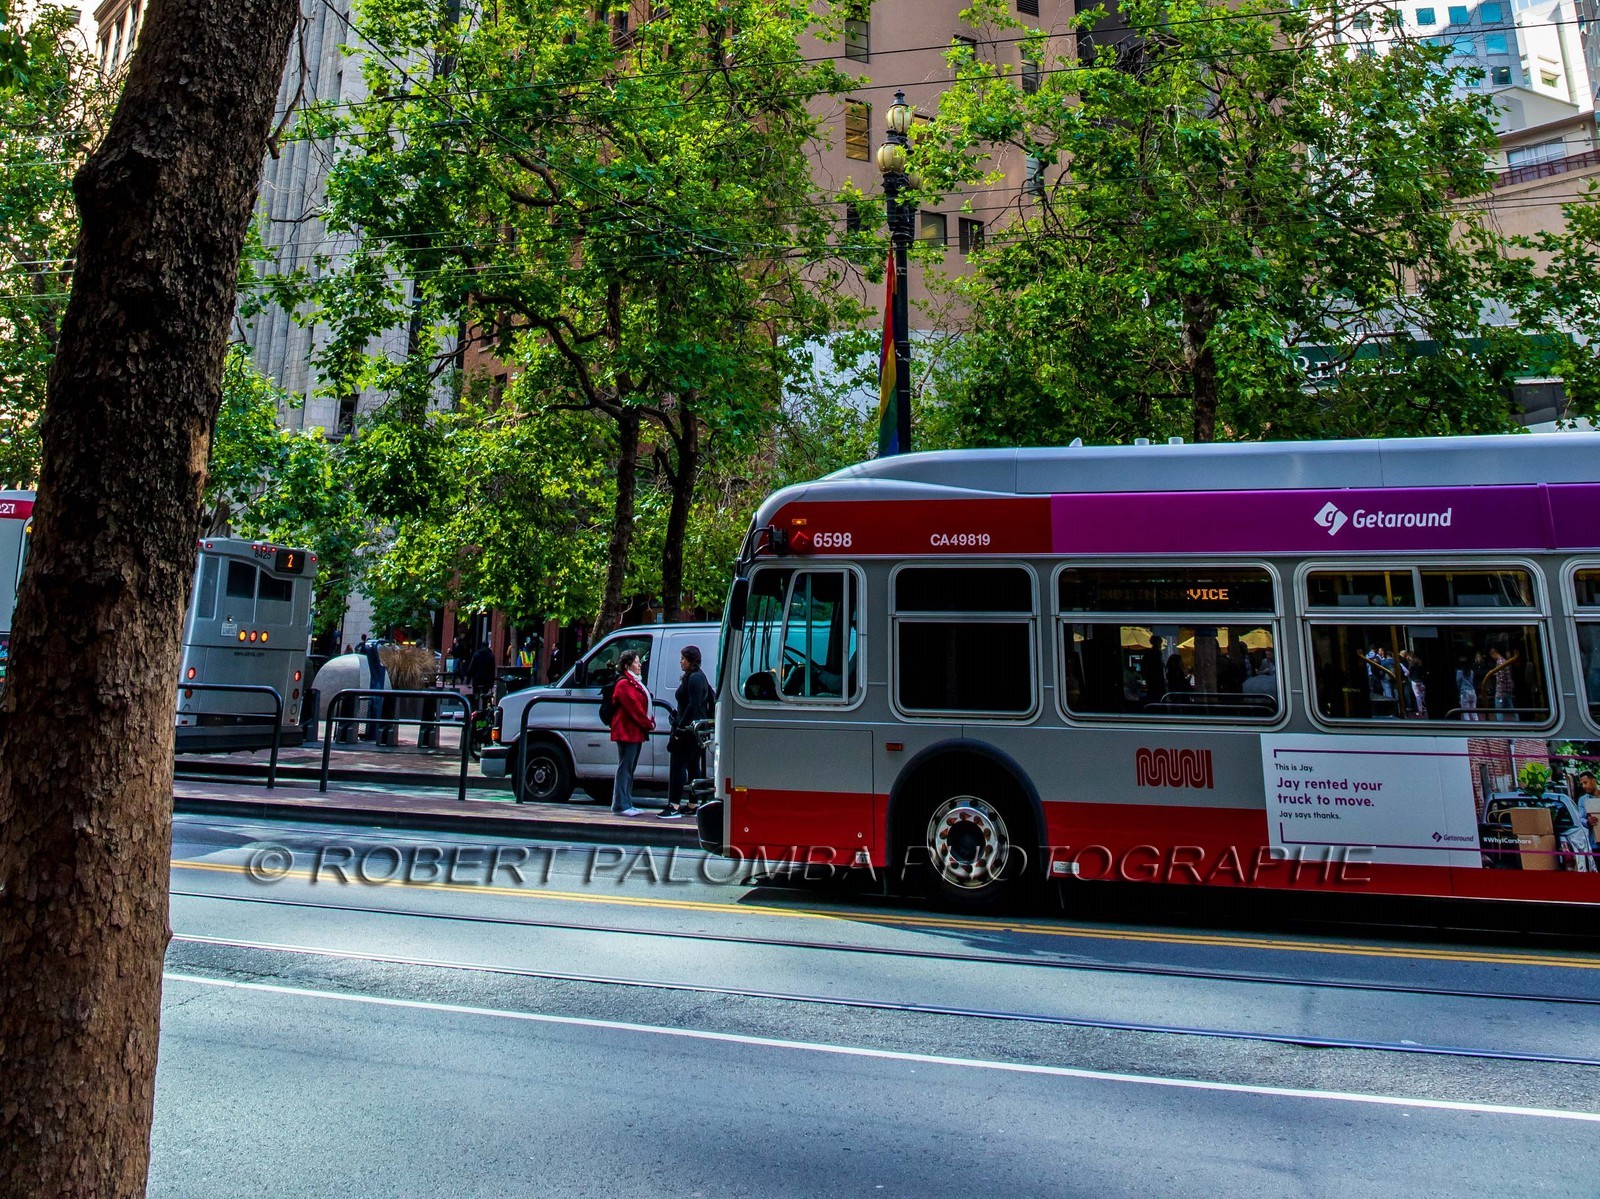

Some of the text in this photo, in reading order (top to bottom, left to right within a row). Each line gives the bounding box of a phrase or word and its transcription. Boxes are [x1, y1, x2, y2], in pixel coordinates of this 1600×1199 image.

[0, 503, 16, 515] 27
[1352, 507, 1453, 529] Getaround
[813, 532, 852, 547] 6598
[930, 533, 991, 547] CA49819
[1275, 763, 1290, 771] This
[1299, 764, 1315, 773] Jay.
[1277, 777, 1383, 793] Jay rented your
[1277, 793, 1375, 807] truck to move.
[1279, 810, 1342, 820] Jay says thanks.
[1443, 834, 1474, 842] Getaround
